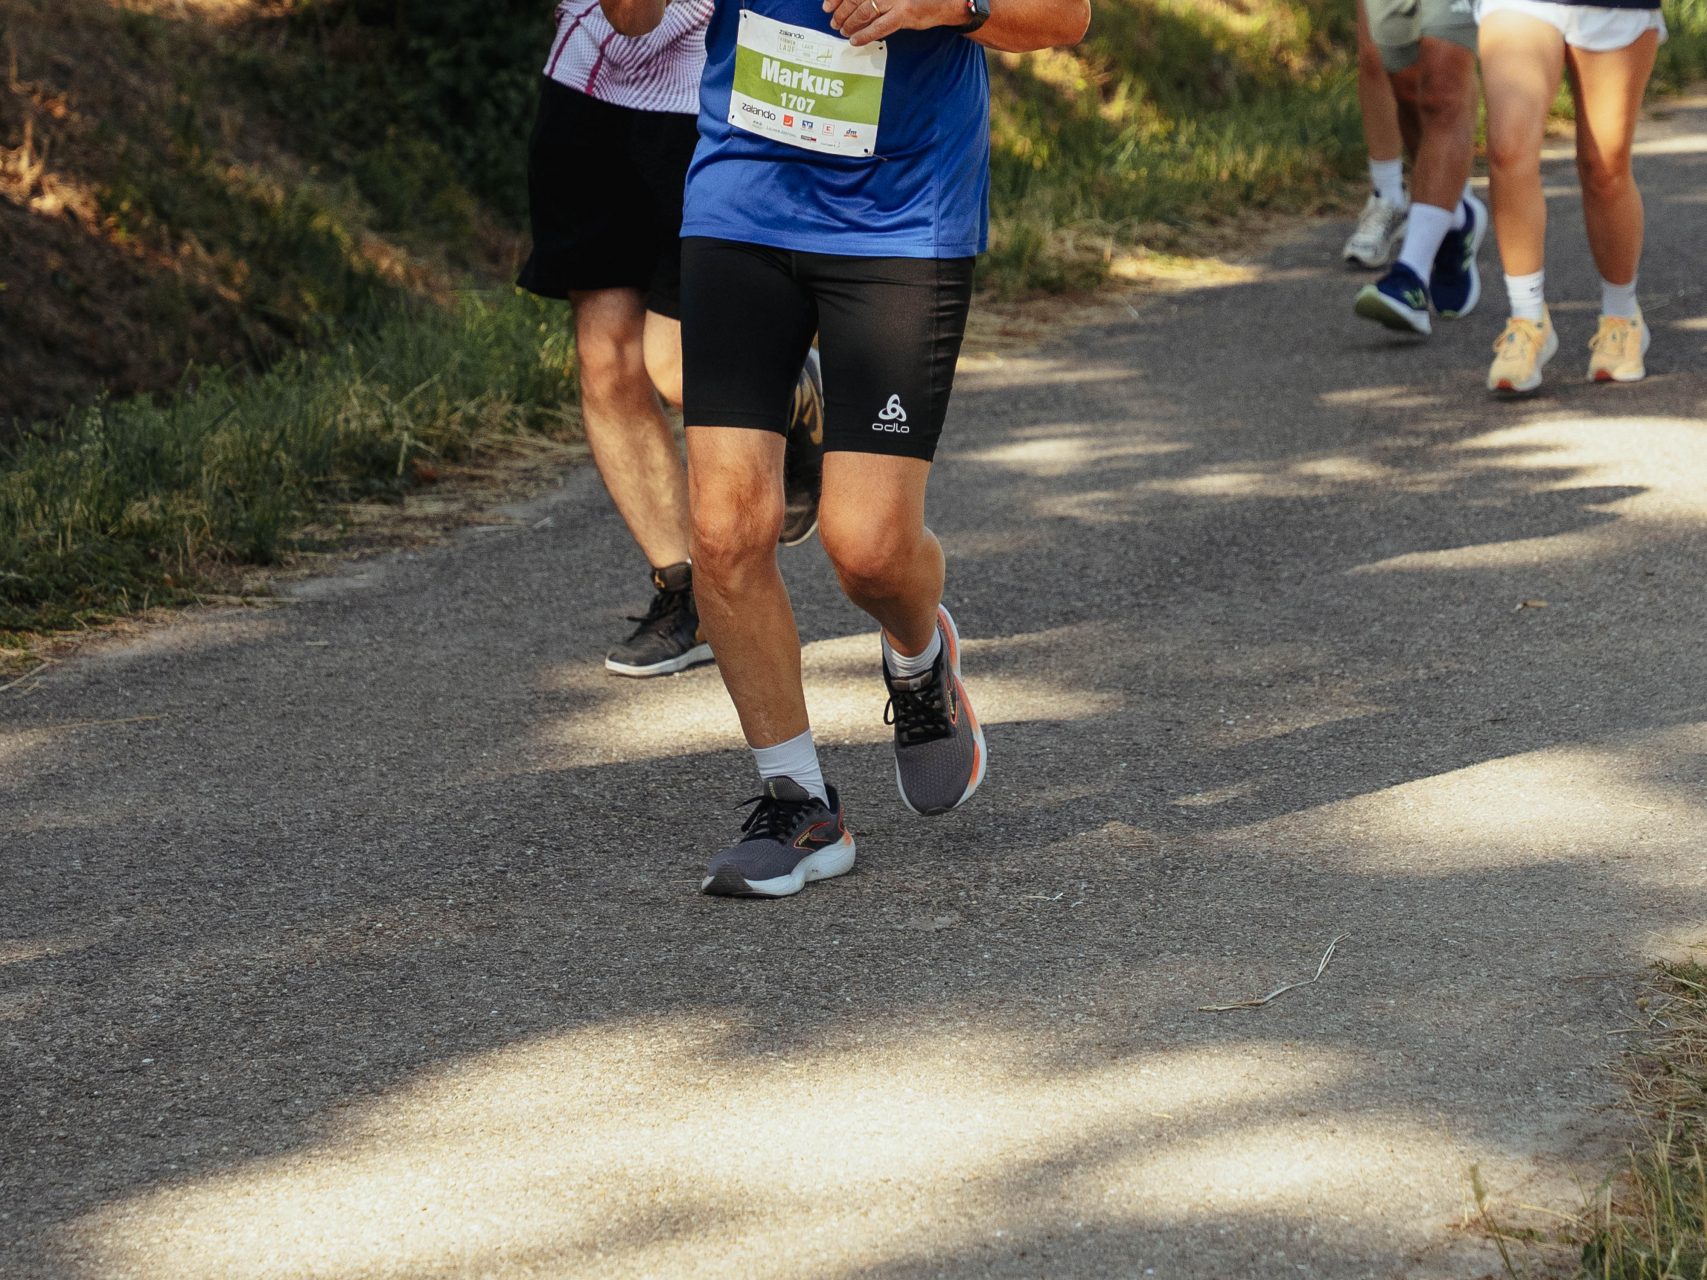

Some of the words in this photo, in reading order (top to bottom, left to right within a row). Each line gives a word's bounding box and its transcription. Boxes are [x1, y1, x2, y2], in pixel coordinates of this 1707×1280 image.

[761, 57, 844, 98] Markus
[741, 102, 776, 121] zalando
[780, 92, 815, 114] 1707
[872, 422, 910, 433] odlo
